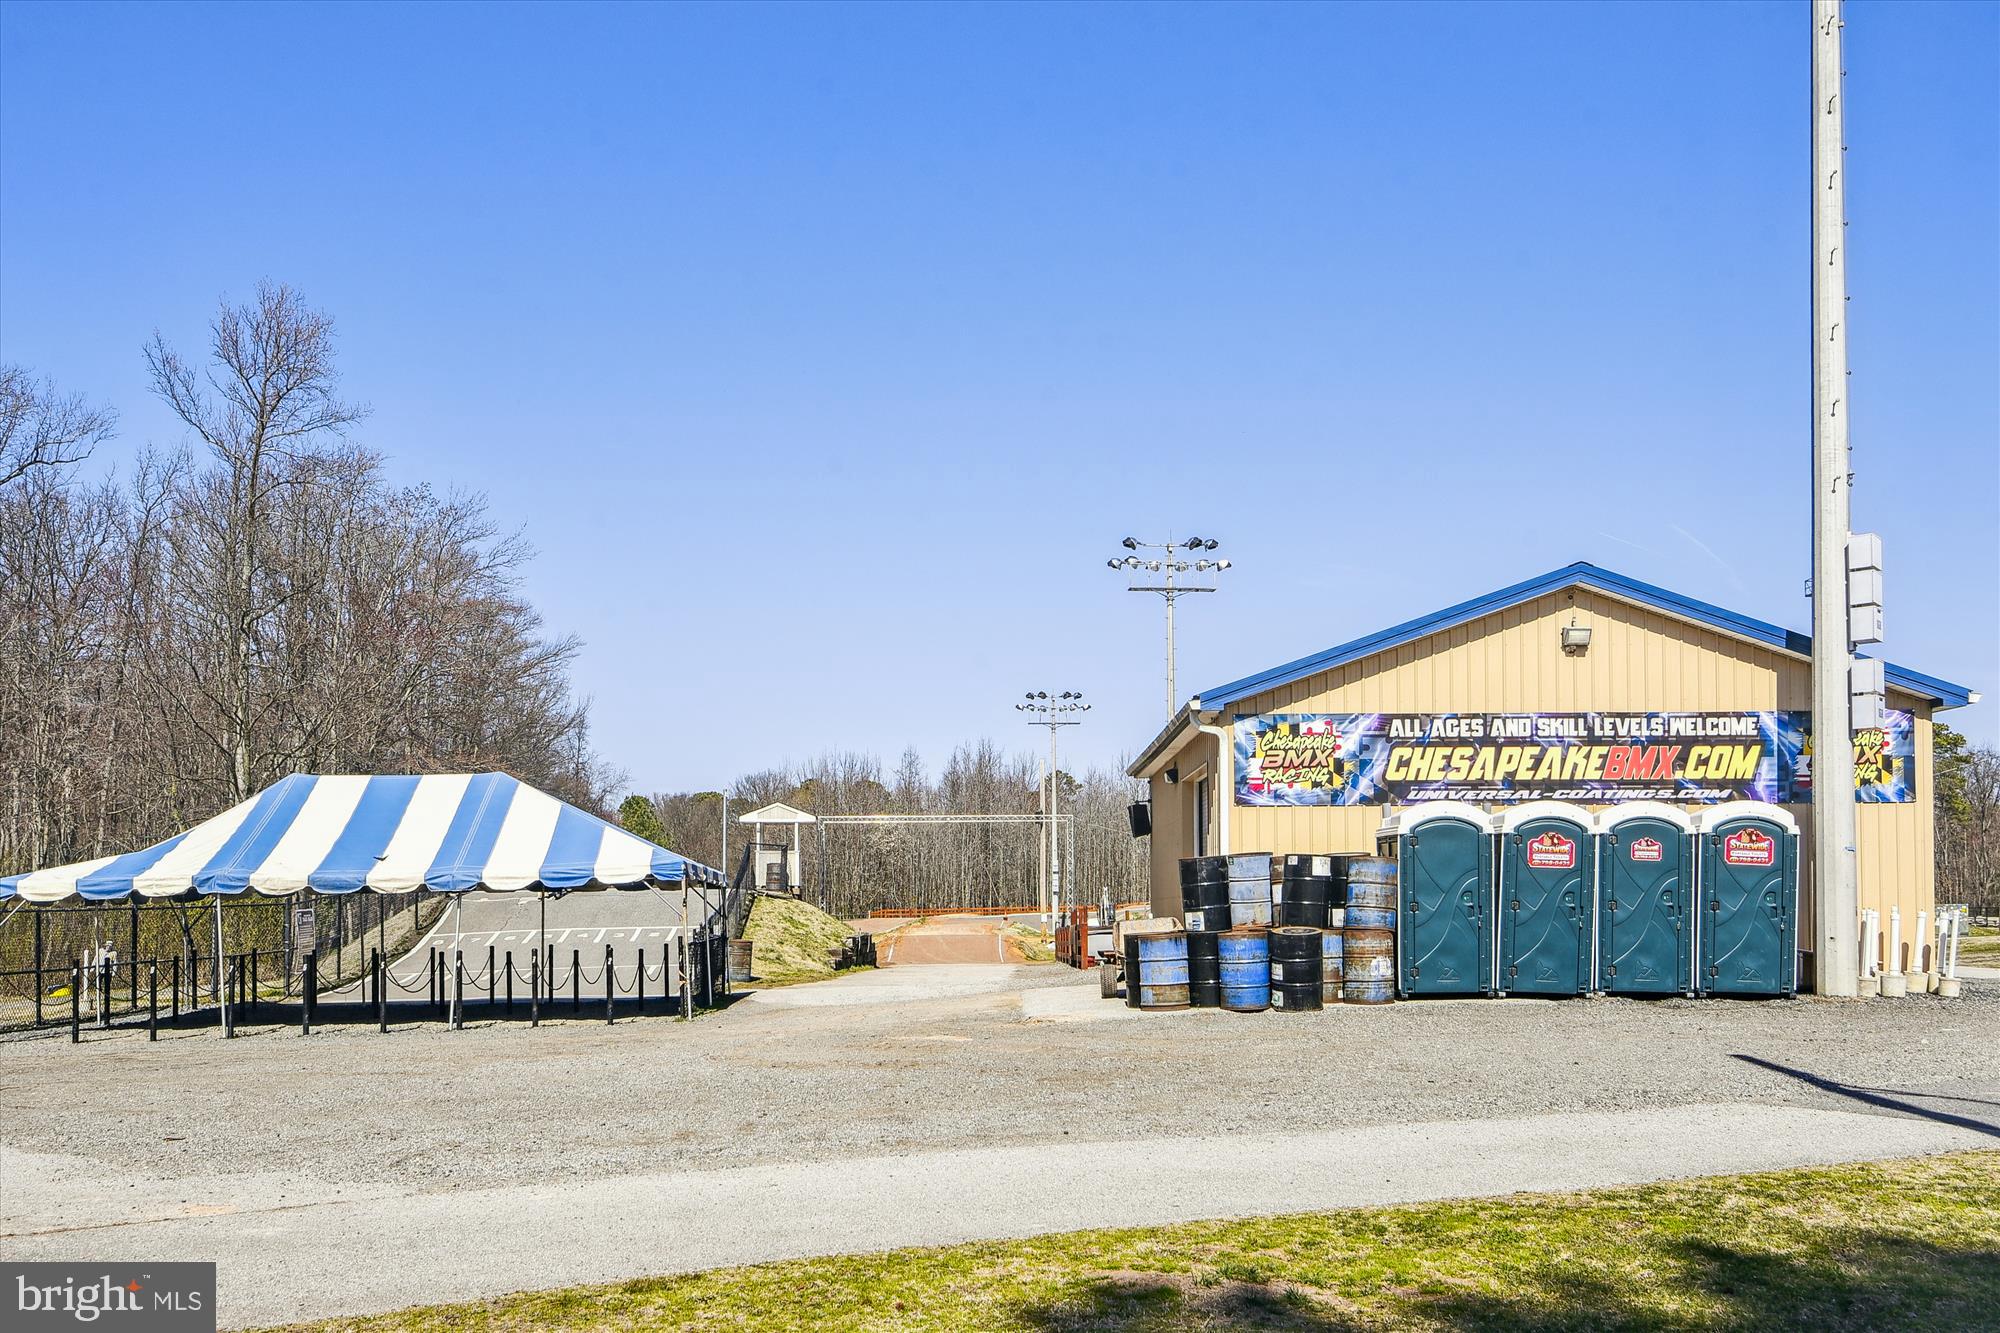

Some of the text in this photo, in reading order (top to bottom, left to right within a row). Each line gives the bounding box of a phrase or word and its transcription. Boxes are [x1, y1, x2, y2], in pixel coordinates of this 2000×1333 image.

[1389, 717, 1758, 738] ALL AGES AND SKILL LEVELS WELCOME
[1260, 728, 1336, 755] Chesapeake
[1262, 748, 1335, 768] BMX
[1385, 745, 1762, 781] CHESAPEAKEBMX.COM
[1261, 765, 1330, 786] RACING
[1406, 788, 1733, 800] UNIVERSAL-COATINGS.COM
